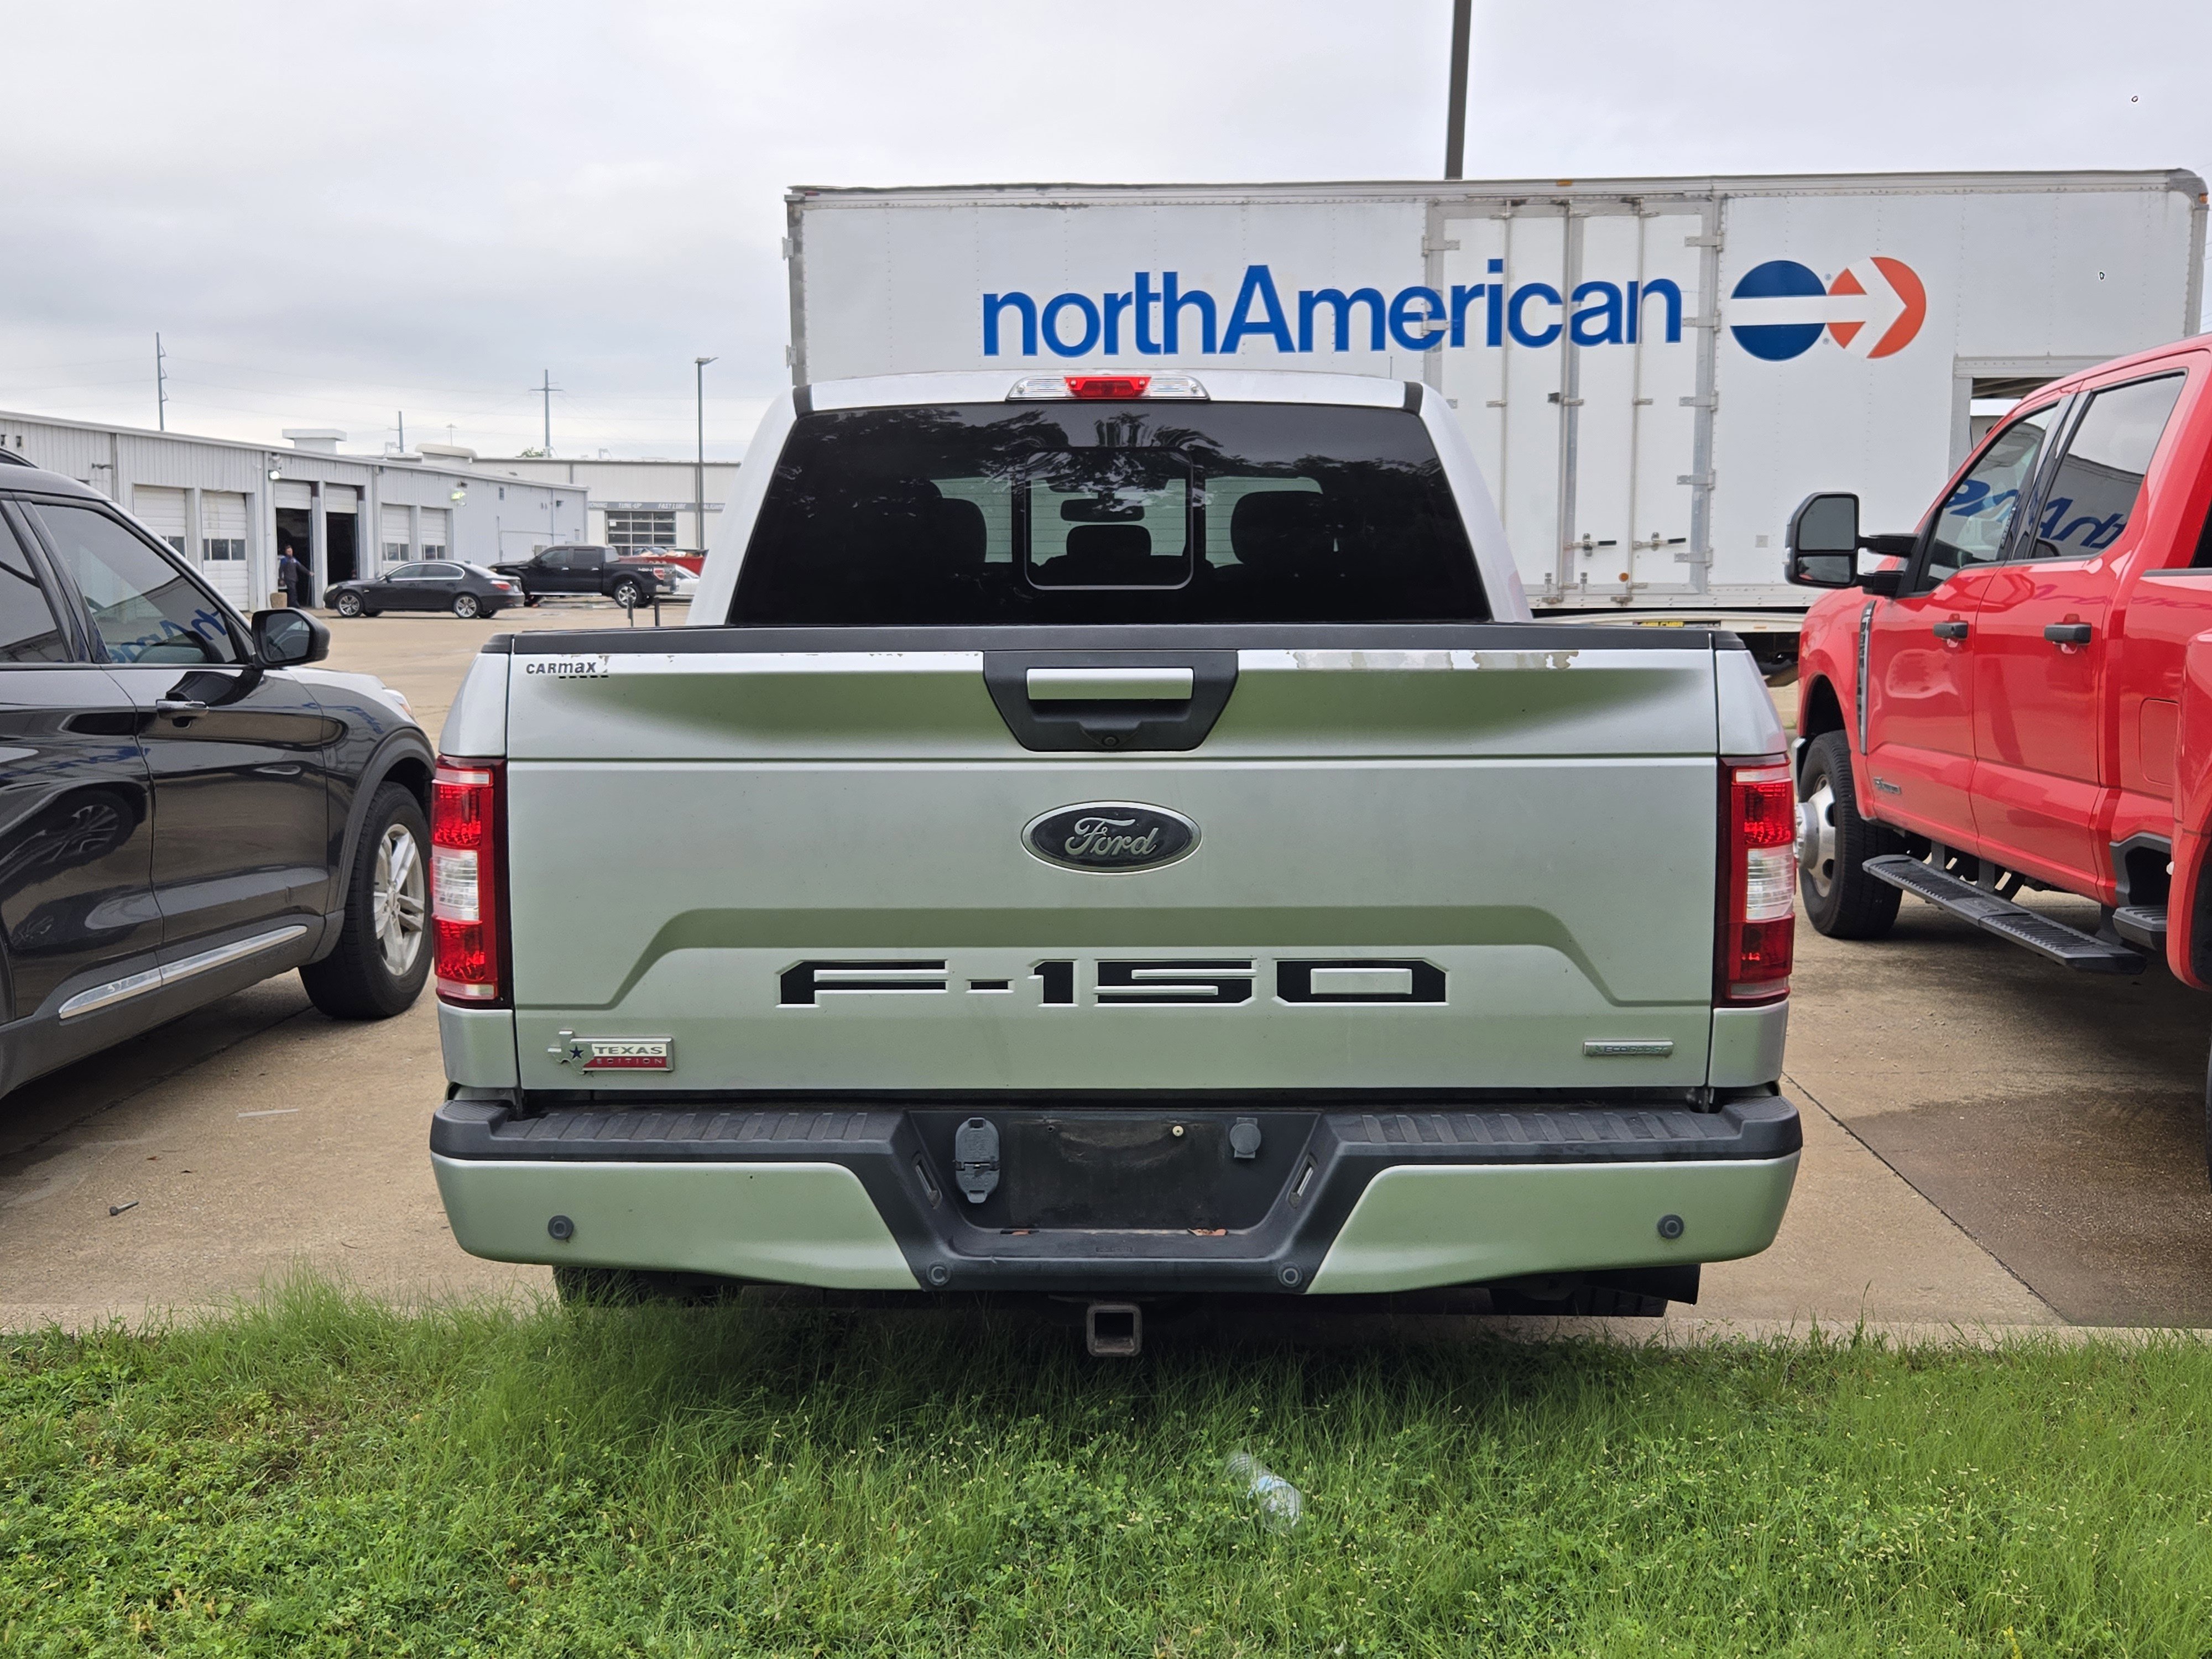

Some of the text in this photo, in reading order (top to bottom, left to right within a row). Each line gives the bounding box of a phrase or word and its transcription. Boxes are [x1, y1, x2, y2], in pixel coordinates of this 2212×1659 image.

[983, 259, 1682, 358] northAmerican
[1065, 817, 1159, 855] Ford
[776, 959, 1451, 1008] F-150
